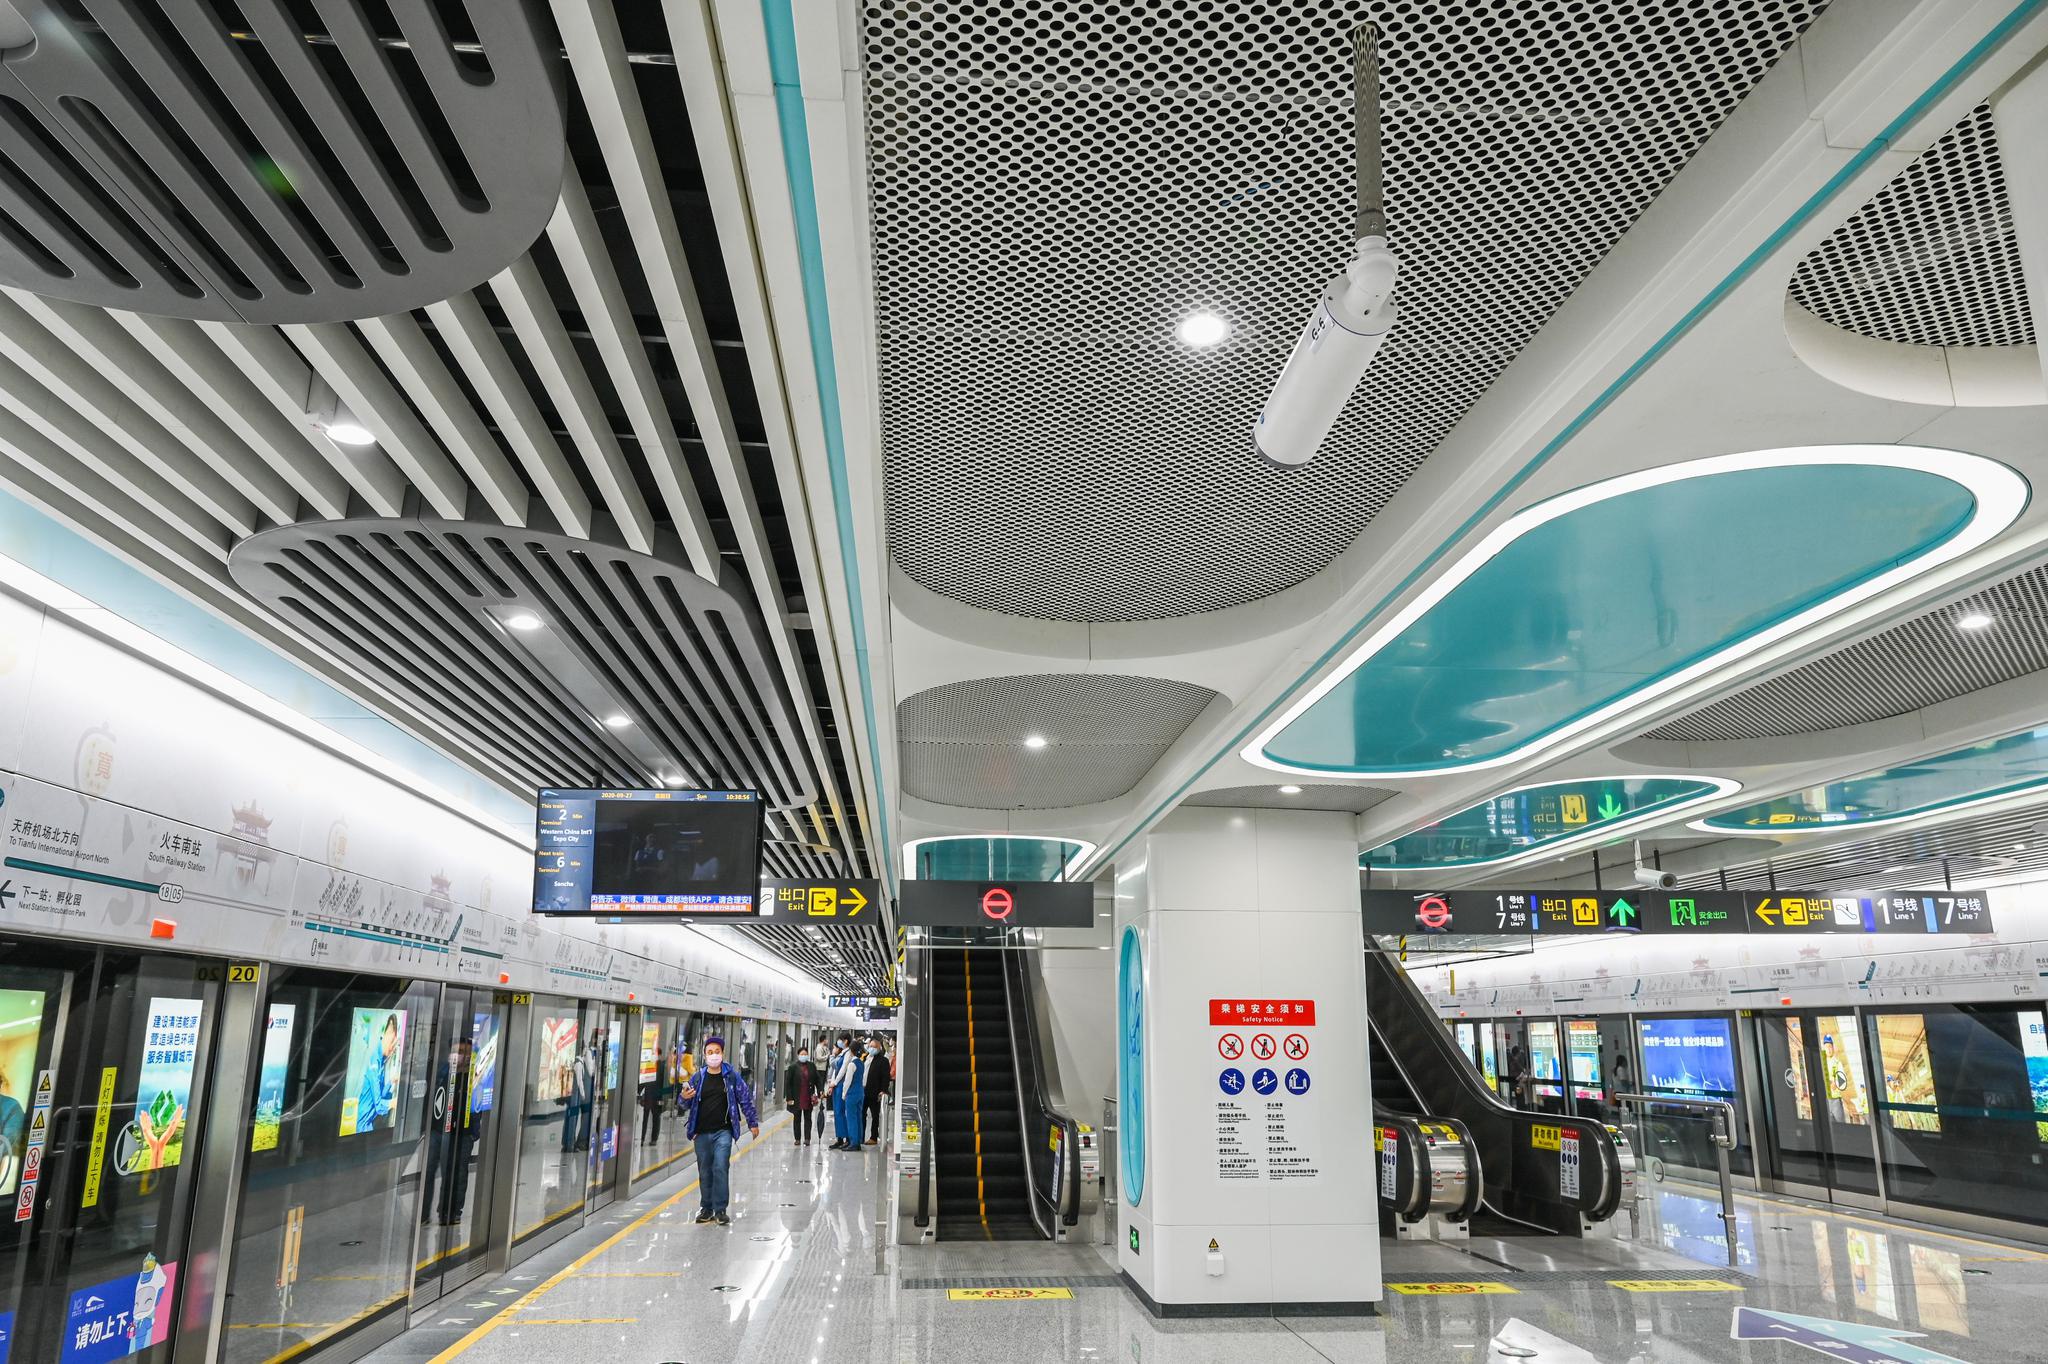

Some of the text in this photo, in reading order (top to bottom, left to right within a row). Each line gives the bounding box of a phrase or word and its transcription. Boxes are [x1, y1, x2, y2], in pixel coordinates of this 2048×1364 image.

[559, 809, 567, 820] 2
[12, 818, 80, 846] 天府机场北方向
[10, 835, 110, 864] To Tianfu International Airport North
[160, 832, 202, 857] 火车南站
[148, 852, 206, 872] South Railway Station
[557, 857, 565, 868] 6
[161, 886, 181, 900] 18 05
[778, 889, 805, 902] 出口
[1496, 895, 1504, 911] 1
[1542, 899, 1567, 911] 出口
[1808, 898, 1832, 911] 出口
[1892, 898, 1918, 911] 号线
[1956, 898, 1982, 911] 号线
[1877, 898, 1890, 924] 1
[1938, 898, 1955, 924] 7
[1496, 912, 1506, 928] 7
[231, 967, 255, 981] 20
[835, 997, 840, 1005] 7
[1222, 1003, 1304, 1014] 乘梯安全须知
[152, 1015, 198, 1028] 建设清洁能源
[150, 1032, 195, 1046] 营造绿色环境
[146, 1050, 193, 1064] 服务智慧城市
[88, 1132, 104, 1199] 请勿上下车
[75, 1311, 129, 1350] 请勿上下
